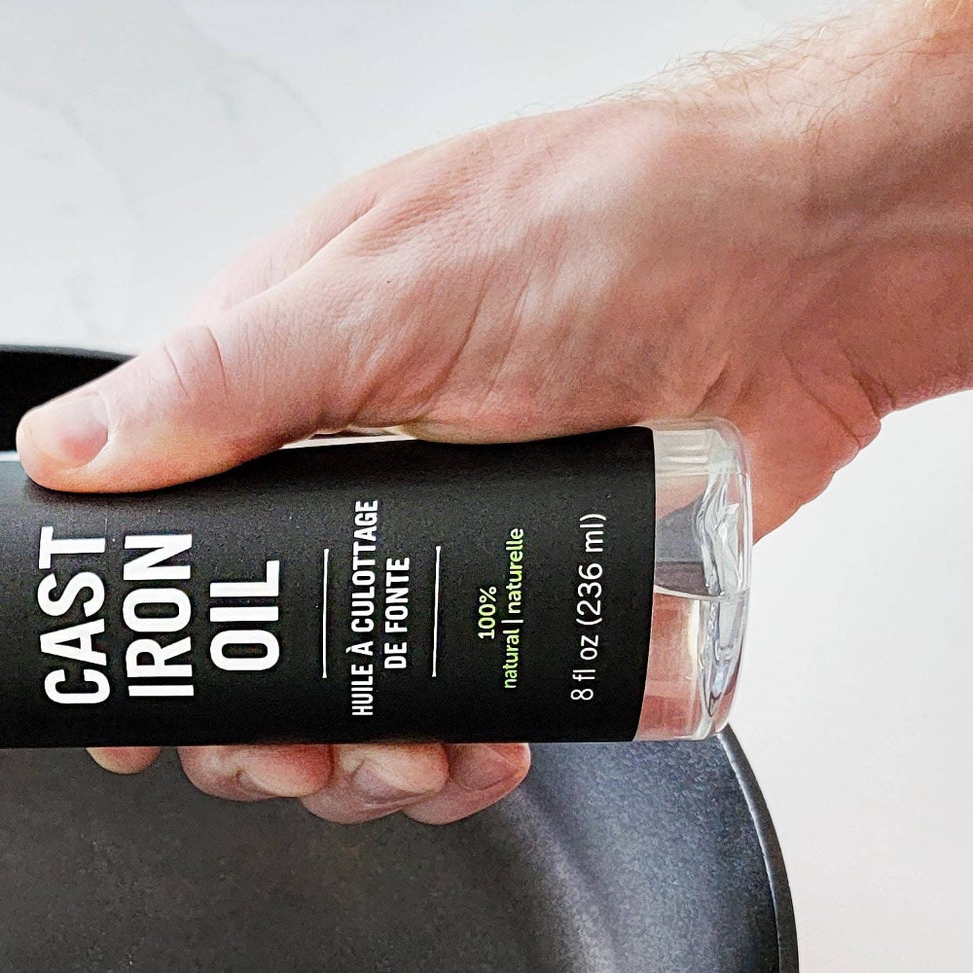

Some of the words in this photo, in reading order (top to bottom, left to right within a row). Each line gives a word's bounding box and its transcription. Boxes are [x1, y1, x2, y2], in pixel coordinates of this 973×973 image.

[579, 513, 607, 553] ml)
[350, 499, 379, 633] CULOTTAGE
[505, 527, 524, 614] naturelle
[575, 562, 603, 626] (236
[36, 525, 111, 705] CAST
[122, 533, 195, 697] IRON
[209, 559, 281, 671] OIL
[384, 556, 411, 634] FONTE
[477, 586, 497, 640] 100%
[345, 640, 374, 657] À
[383, 641, 408, 669] DE
[502, 628, 520, 689] natural
[572, 669, 596, 682] fl
[579, 634, 599, 661] oz
[350, 663, 374, 716] HUILE
[570, 688, 594, 701] 8
